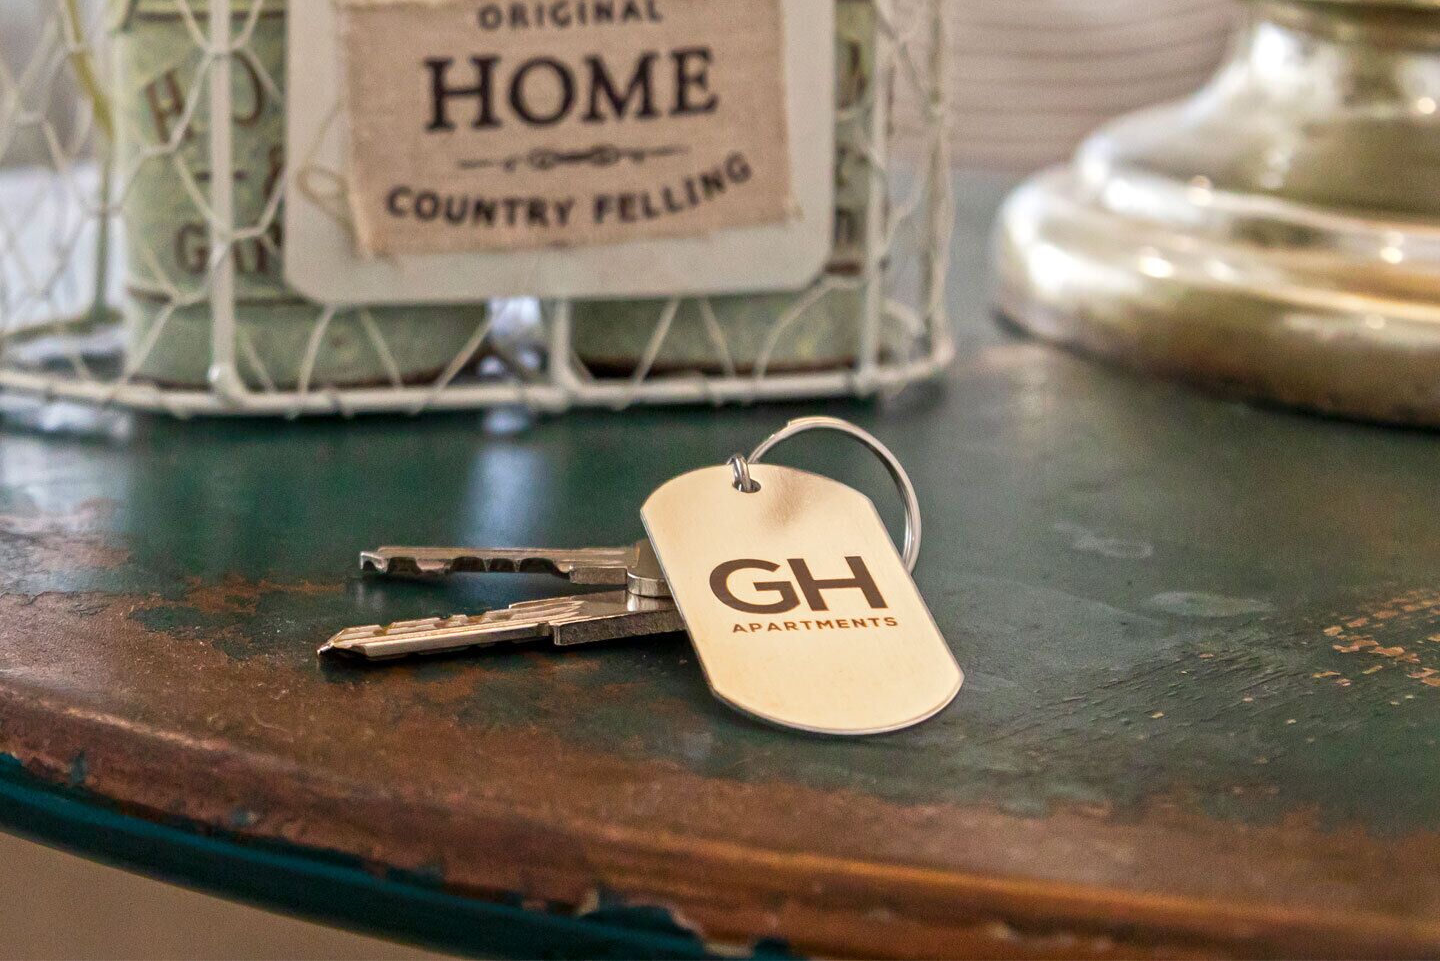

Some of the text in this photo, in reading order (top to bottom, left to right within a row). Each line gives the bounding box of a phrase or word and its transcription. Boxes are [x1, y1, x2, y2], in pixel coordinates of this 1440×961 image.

[422, 45, 719, 133] HOME
[386, 152, 752, 228] COUNTRY FELLING
[709, 555, 889, 615] GH
[732, 616, 899, 633] APARTMENTS
